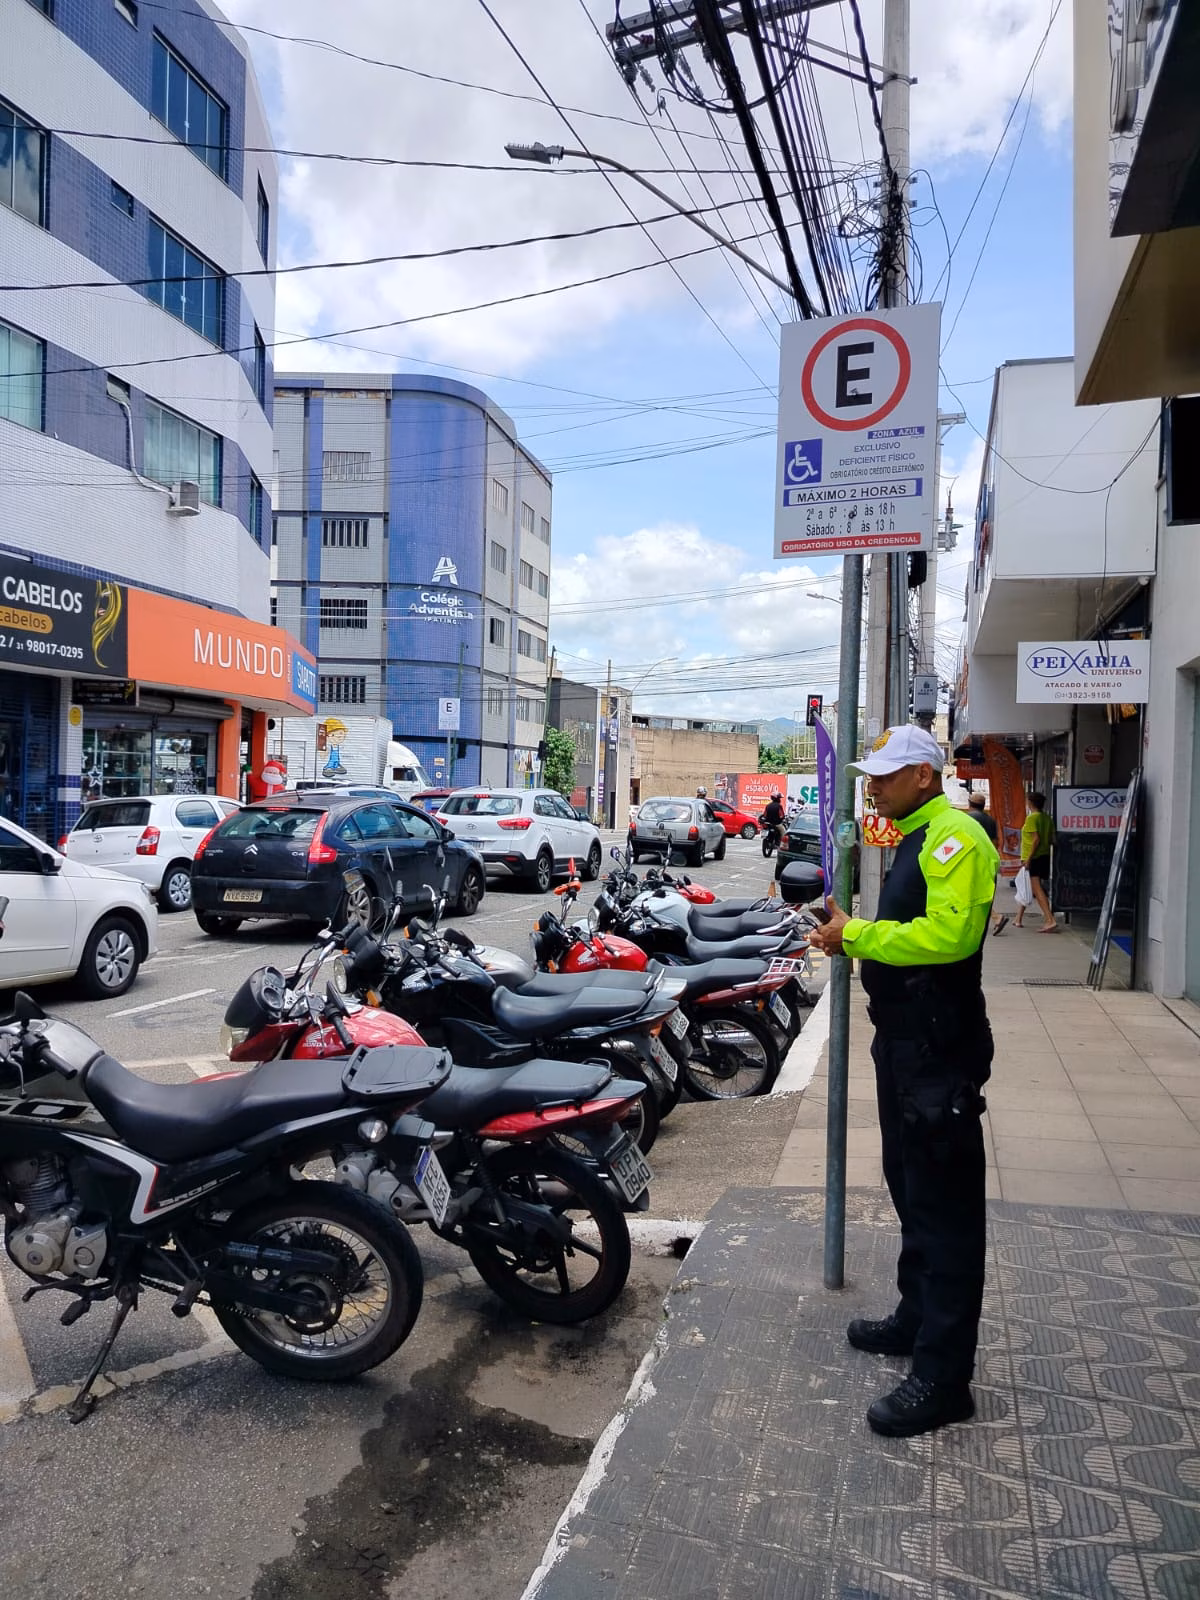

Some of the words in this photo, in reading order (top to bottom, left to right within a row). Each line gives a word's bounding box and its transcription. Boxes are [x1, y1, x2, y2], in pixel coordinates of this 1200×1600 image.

[835, 341, 875, 408] E
[872, 430, 895, 439] ZONA
[898, 428, 920, 437] AZUL
[854, 442, 901, 452] EXCLUSIVO
[839, 454, 887, 466] DEFICIENTE
[888, 452, 916, 462] FÍSICO
[830, 466, 868, 479] OBRIGATÓRIO
[869, 464, 891, 475] CRÉDITO
[892, 463, 925, 474] ELETRÔNICO
[797, 489, 847, 503] MÁXIMO
[850, 488, 857, 498] 2
[860, 485, 907, 497] HORAS
[818, 510, 823, 519] a
[864, 504, 874, 517] às
[879, 502, 888, 515] 18
[890, 501, 896, 514] h
[806, 523, 835, 537] Sábado
[846, 521, 852, 534] 8
[861, 520, 870, 532] às
[876, 519, 885, 531] 13
[889, 518, 895, 531] h
[783, 540, 834, 551] OBRIGATÓRIO
[836, 540, 852, 548] USO
[854, 539, 866, 547] DA
[867, 536, 919, 546] CREDENCIAL
[2, 576, 83, 614] CABELOS
[420, 592, 464, 607] Colégio
[409, 603, 474, 620] Adventisa
[26, 639, 84, 659] 98017-0295
[194, 628, 283, 678] MUNDO
[1030, 650, 1132, 675] PEIXARIA
[1091, 668, 1142, 676] UNIVERSO
[446, 702, 453, 712] E
[1061, 815, 1106, 829] OFERTA
[423, 1159, 438, 1197] RFC
[625, 1162, 651, 1198] 0940
